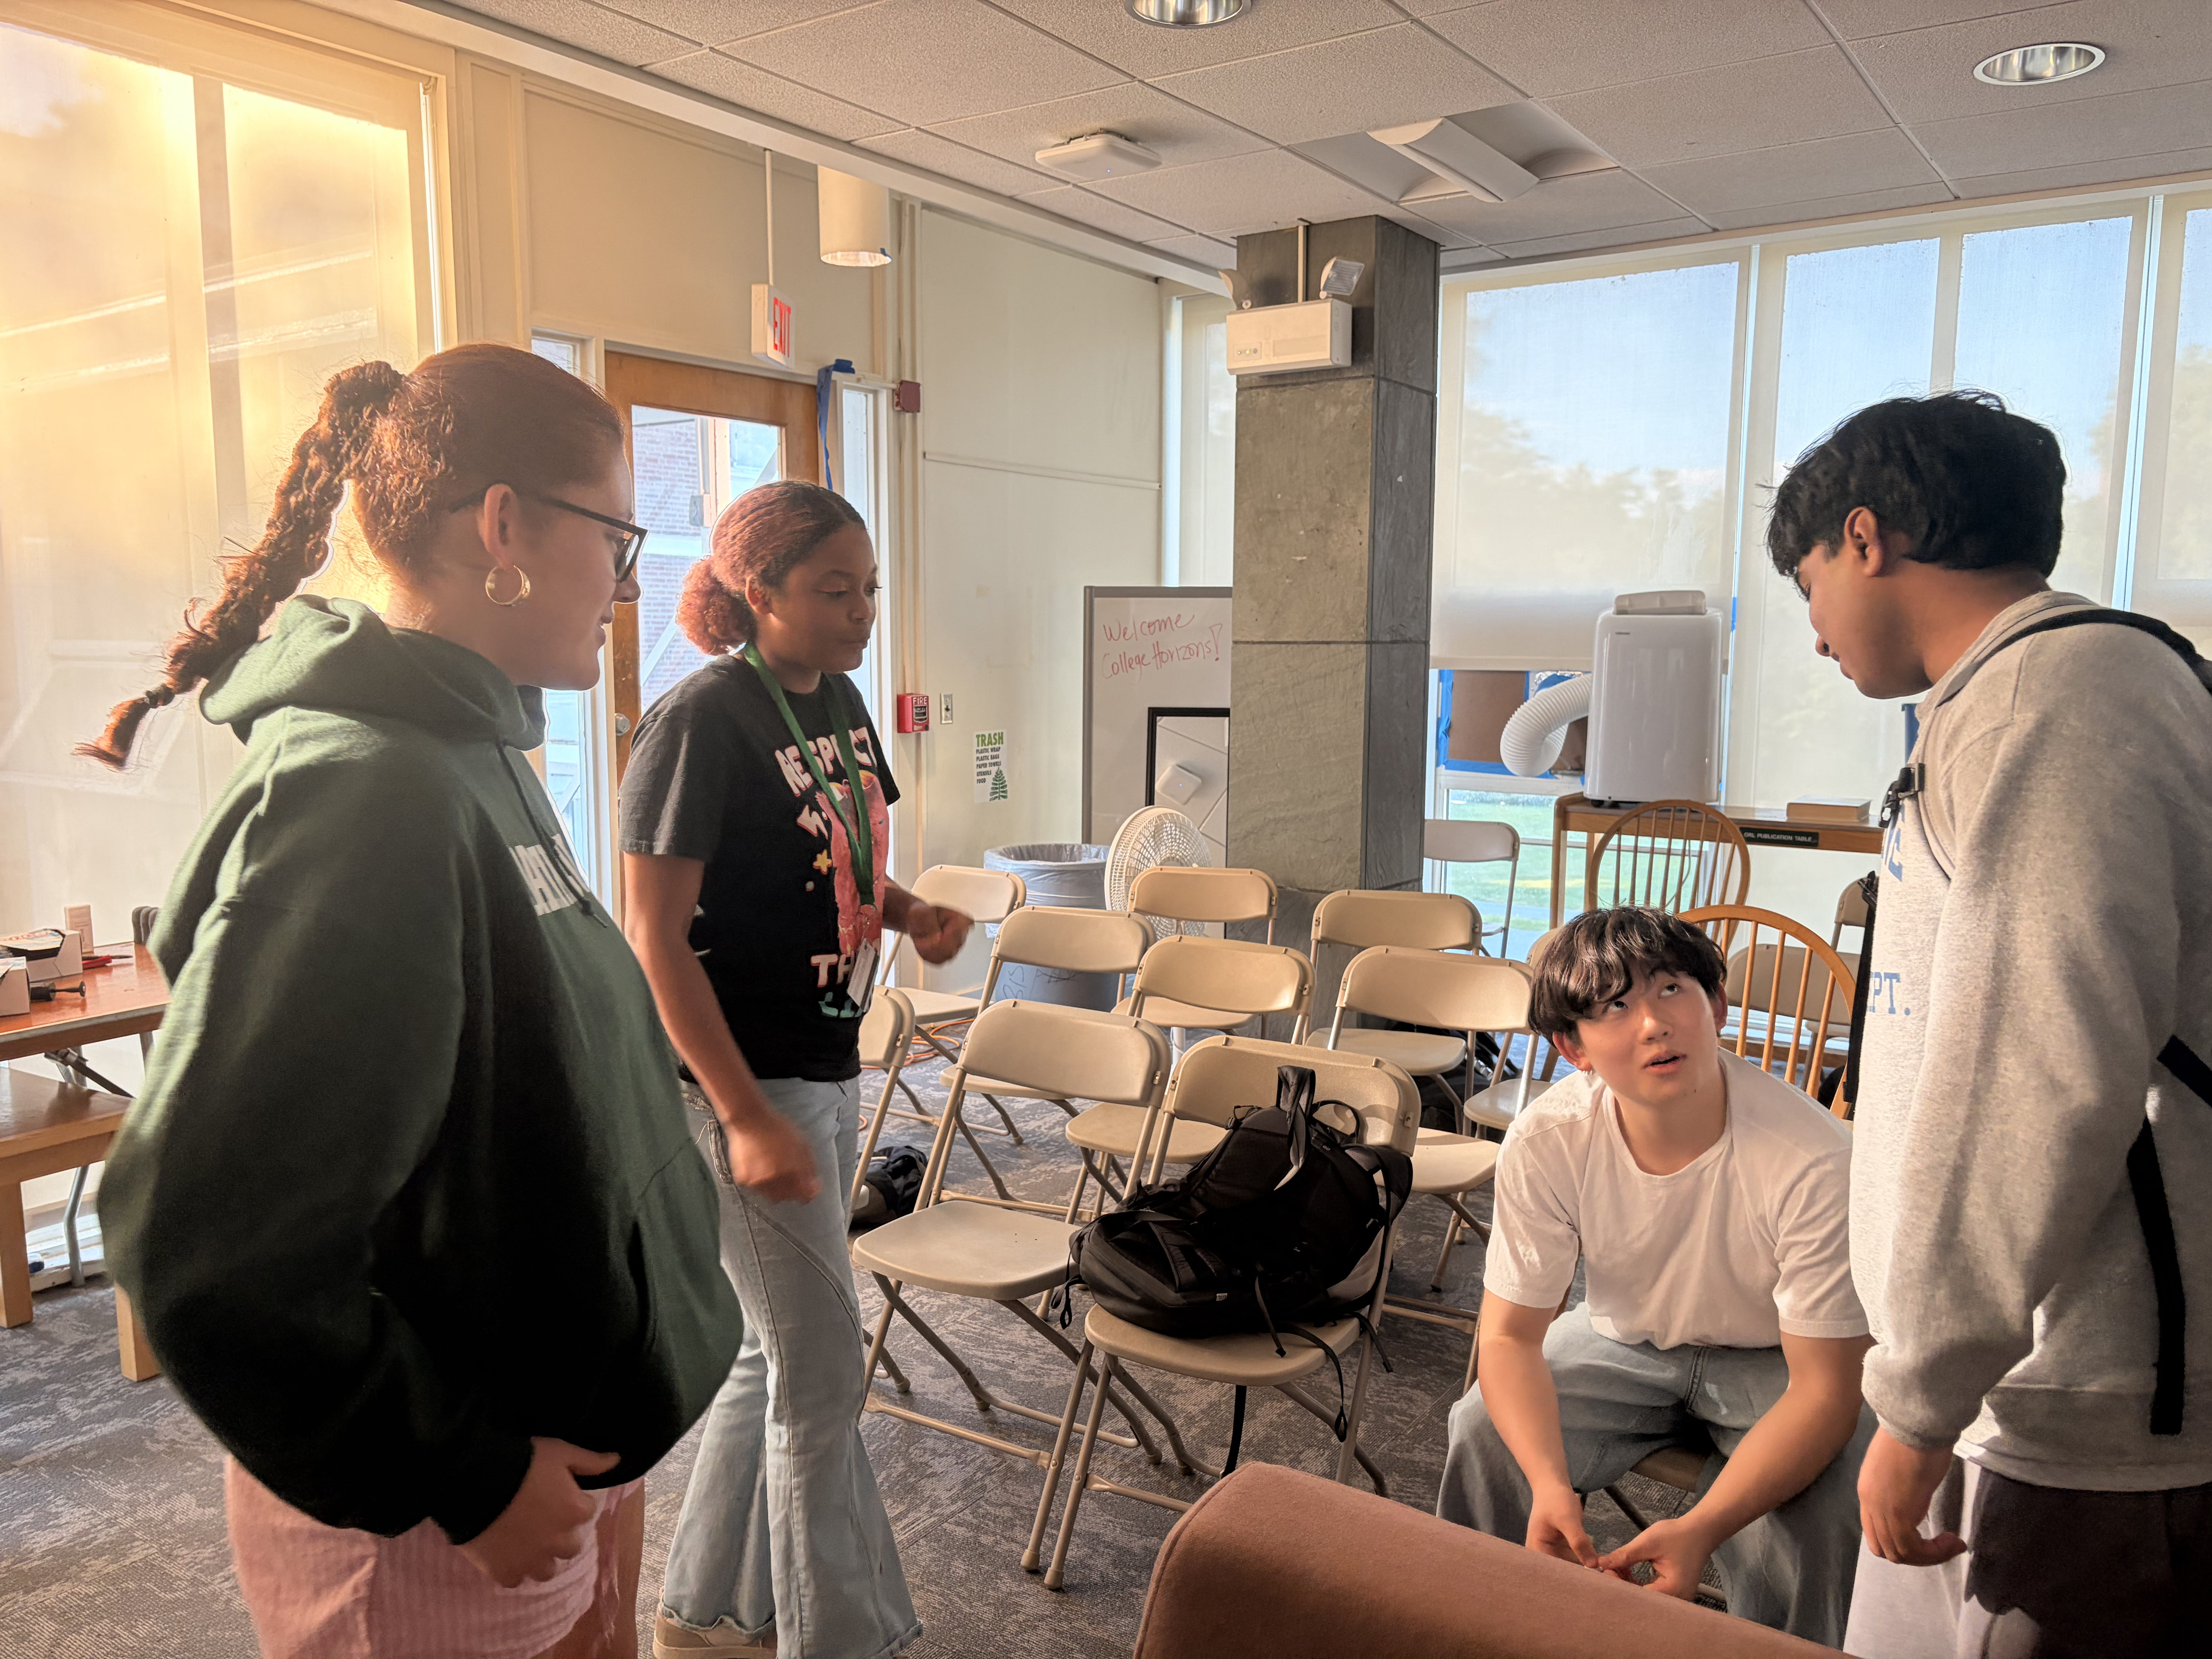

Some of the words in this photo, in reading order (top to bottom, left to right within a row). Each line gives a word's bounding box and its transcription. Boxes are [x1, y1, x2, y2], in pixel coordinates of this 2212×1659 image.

[773, 297, 791, 358] EXIT
[1103, 613, 1195, 641] Welcome
[1101, 651, 1151, 685] College
[1152, 623, 1223, 670] Horizons!
[913, 697, 927, 705] FIRE
[975, 732, 1004, 747] TRASH
[811, 950, 855, 988] TH
